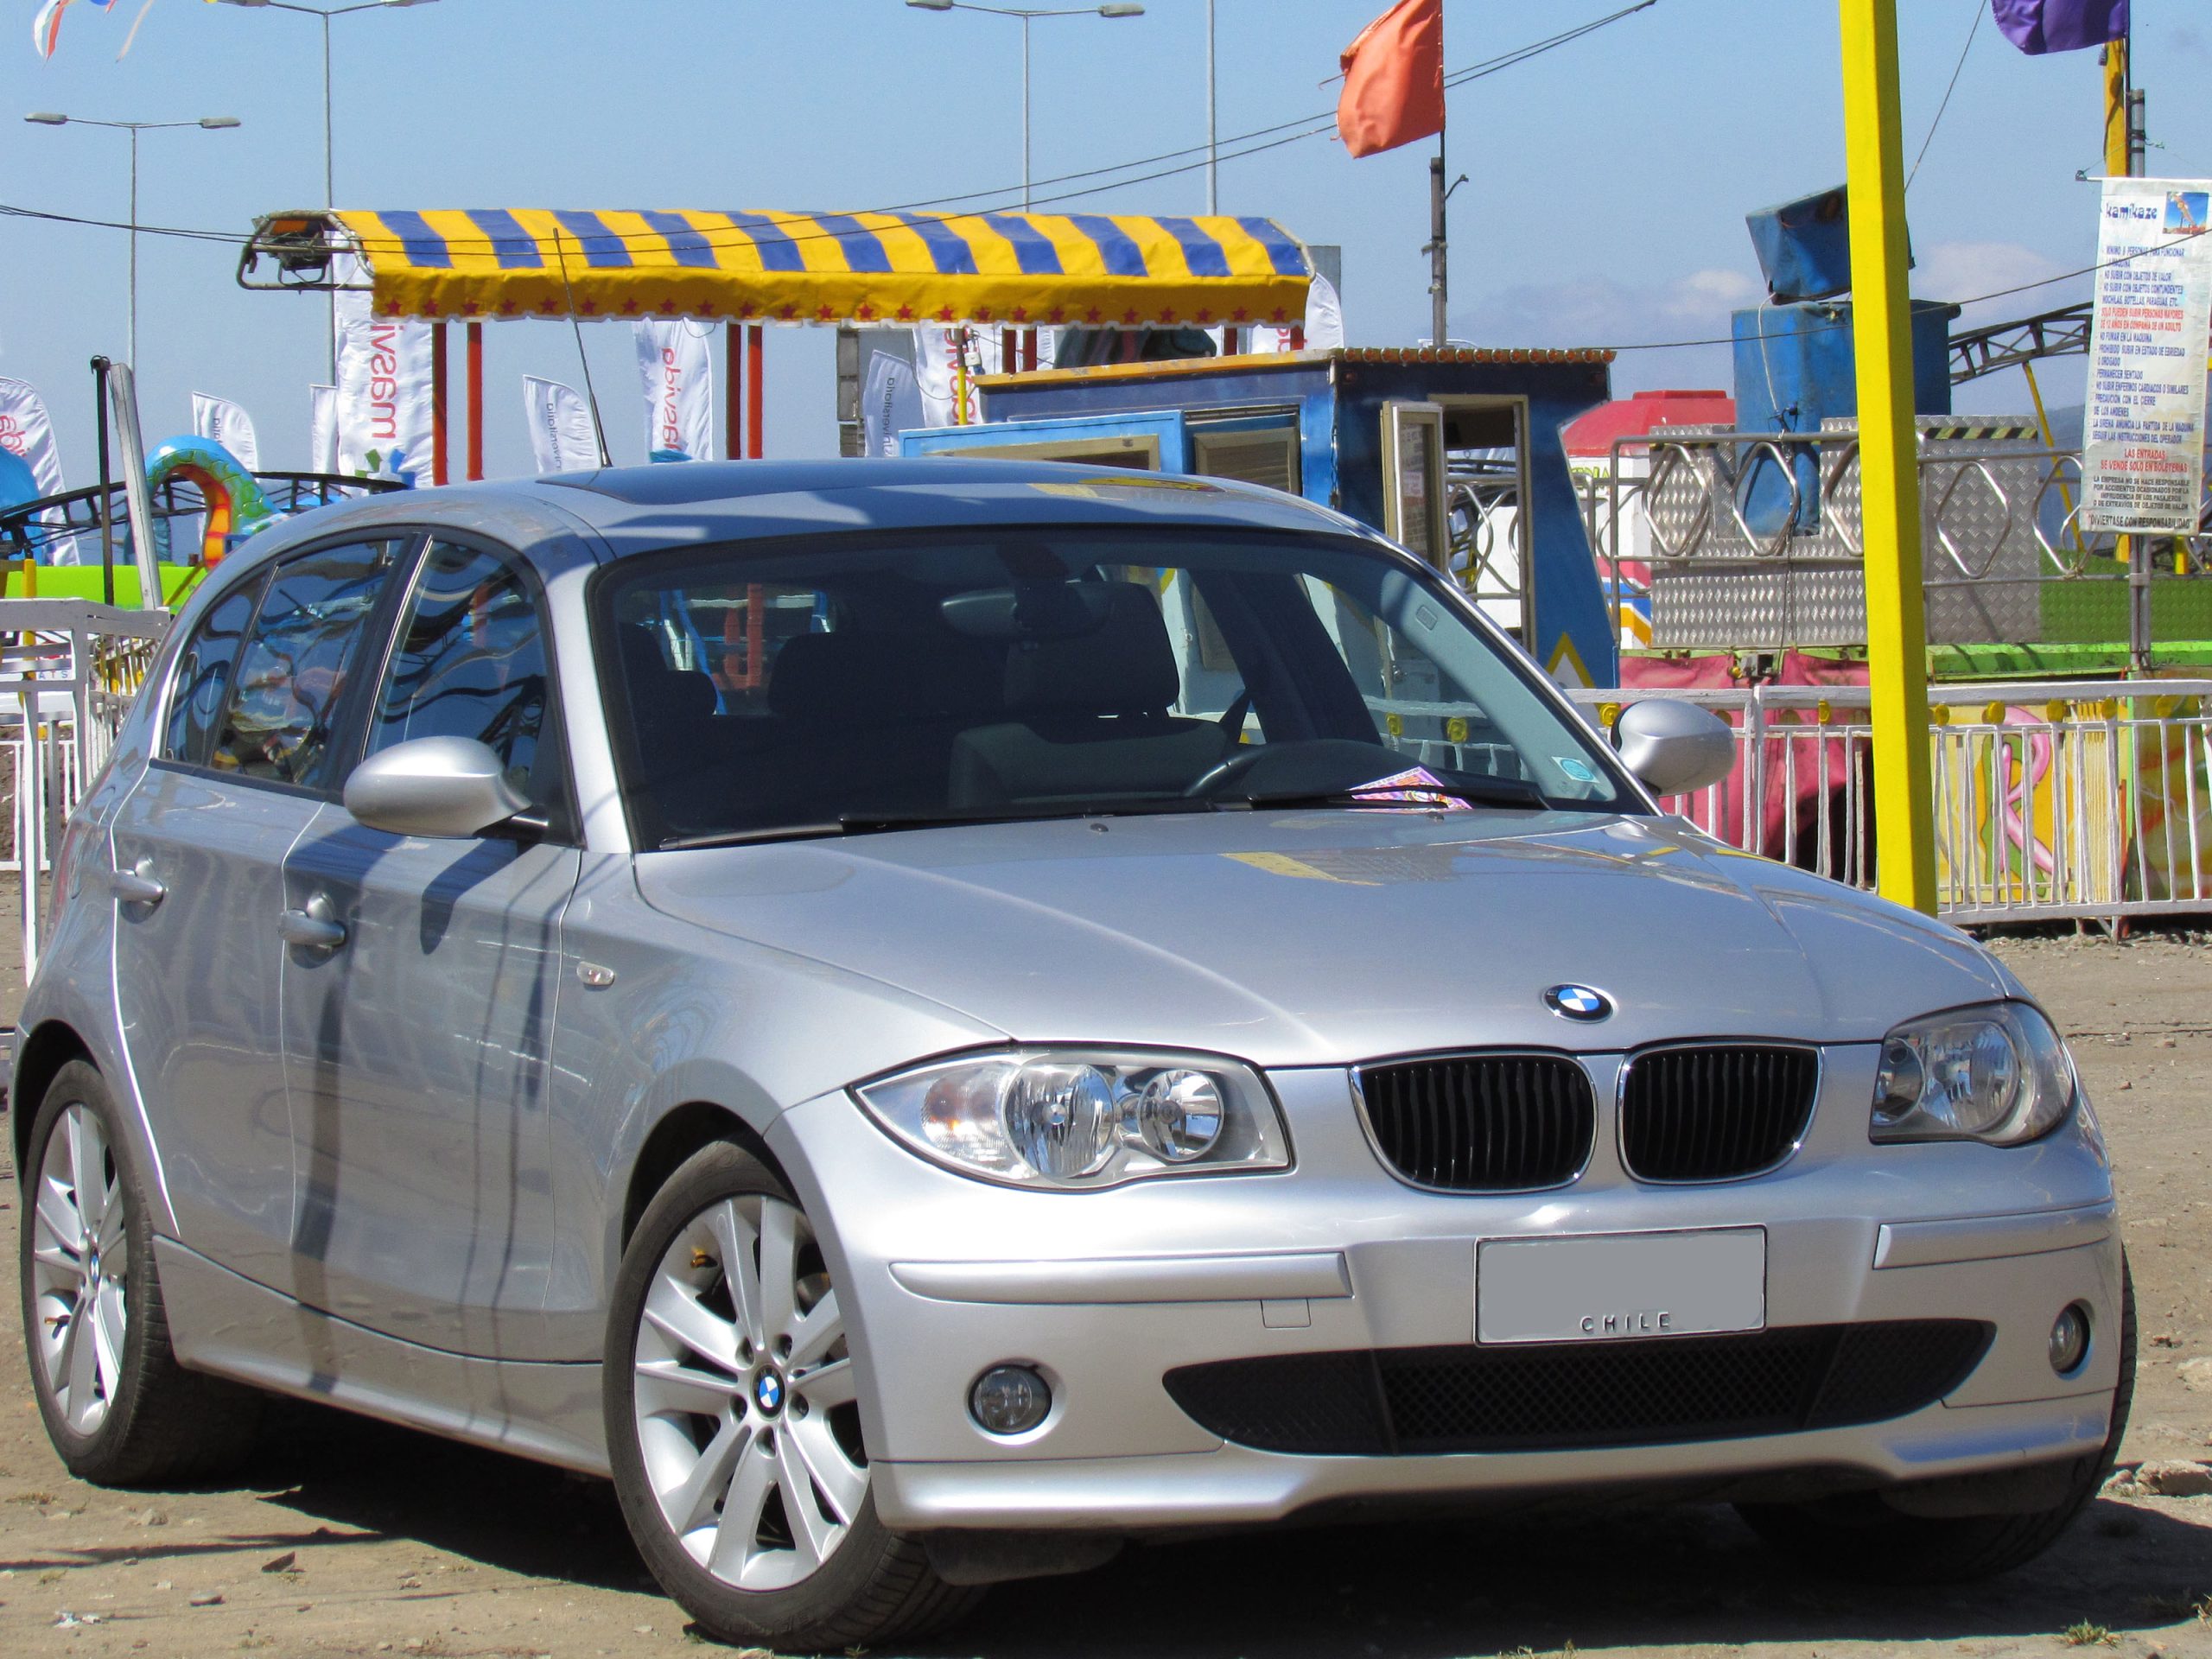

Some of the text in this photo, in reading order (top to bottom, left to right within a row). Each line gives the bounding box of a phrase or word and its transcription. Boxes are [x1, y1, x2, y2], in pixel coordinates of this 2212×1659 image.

[2106, 202, 2158, 219] kamikaze
[2124, 448, 2165, 460] LAS ENTRADAS
[2101, 460, 2108, 469] SE
[2109, 460, 2128, 471] VENDE
[2129, 461, 2144, 472] SOLO
[2145, 461, 2153, 473] EN
[2124, 516, 2138, 527] CON
[1580, 1311, 1670, 1334] CHILE
